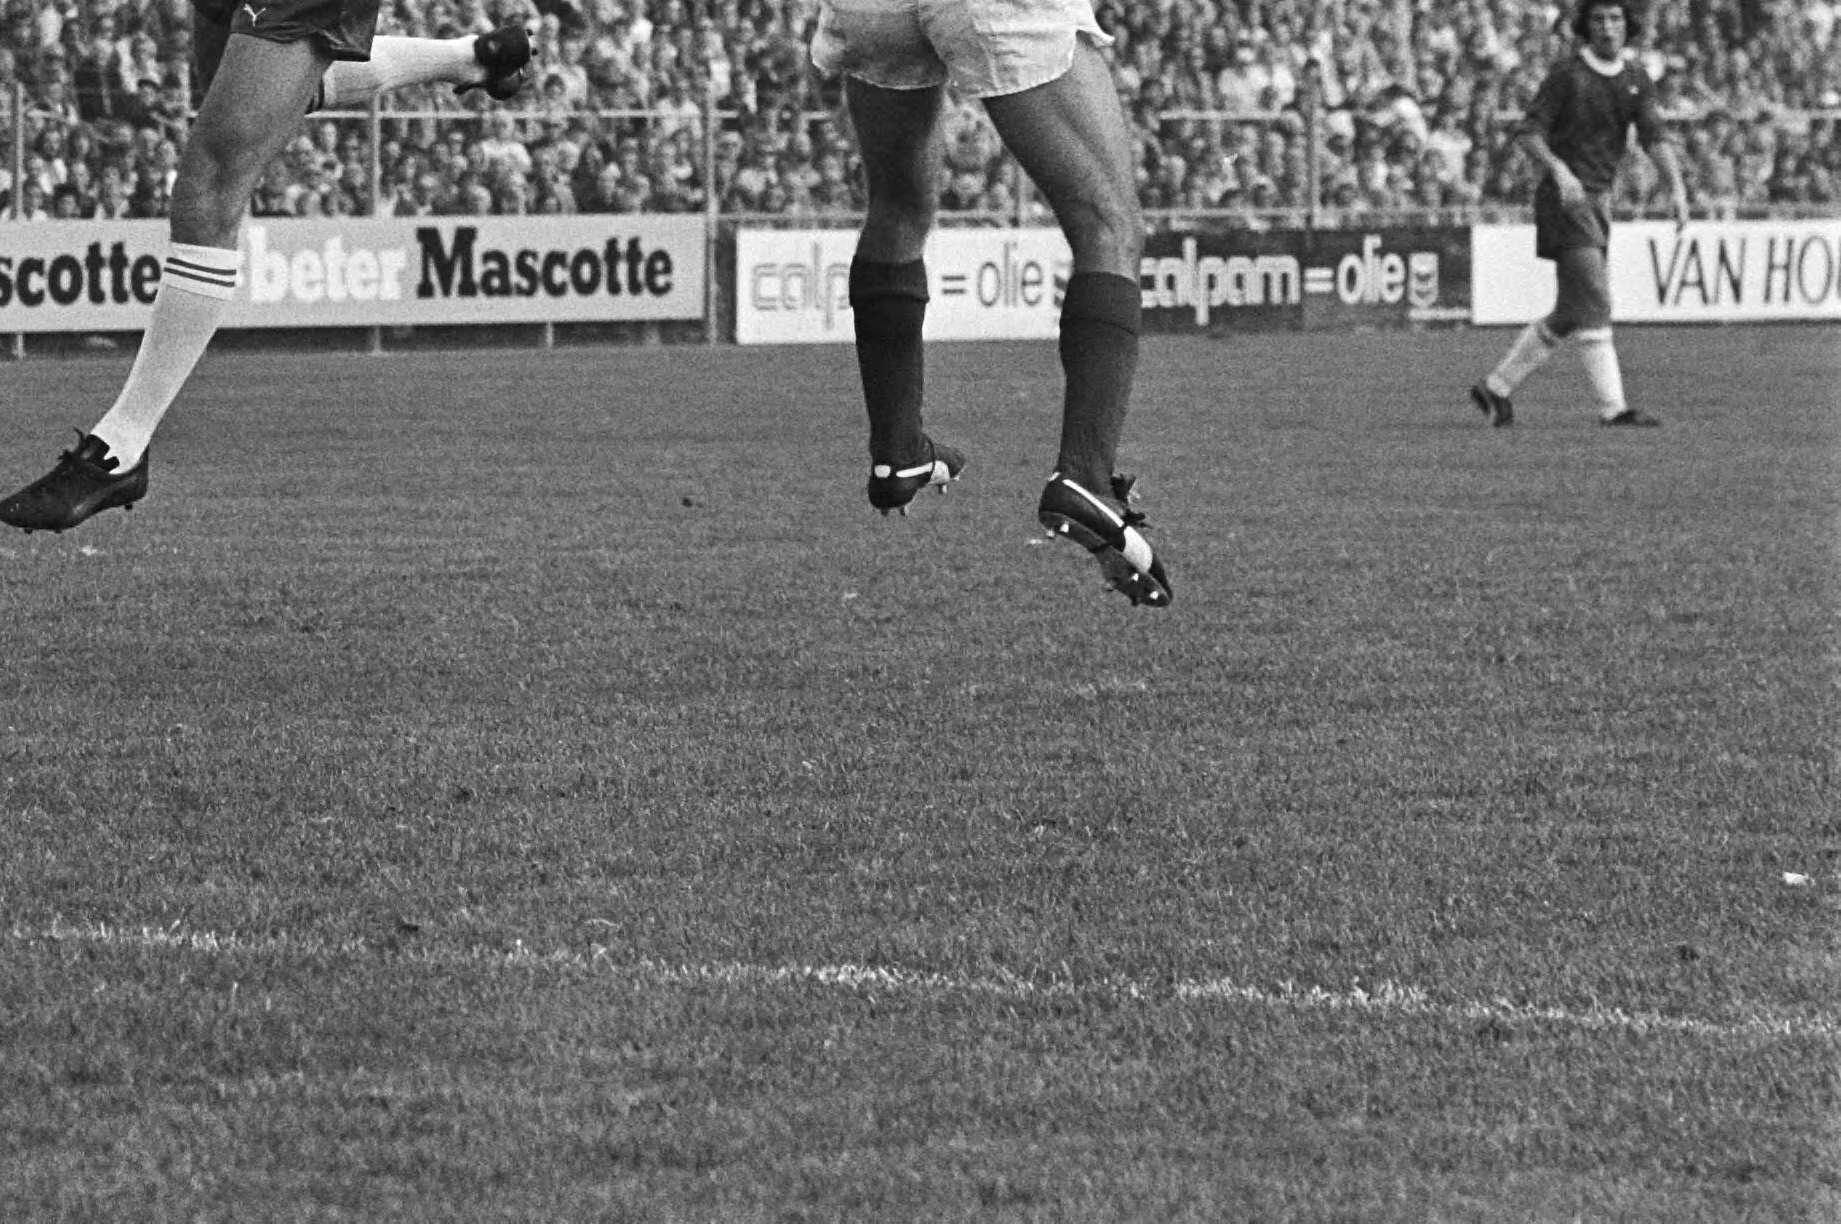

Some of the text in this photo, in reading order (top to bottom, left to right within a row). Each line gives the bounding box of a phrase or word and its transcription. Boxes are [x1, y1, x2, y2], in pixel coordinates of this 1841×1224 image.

[246, 226, 407, 302] beter
[416, 226, 673, 299] Mascotte
[750, 242, 853, 331] calp
[976, 241, 1044, 308] olie
[1649, 235, 1841, 306] VAN HO
